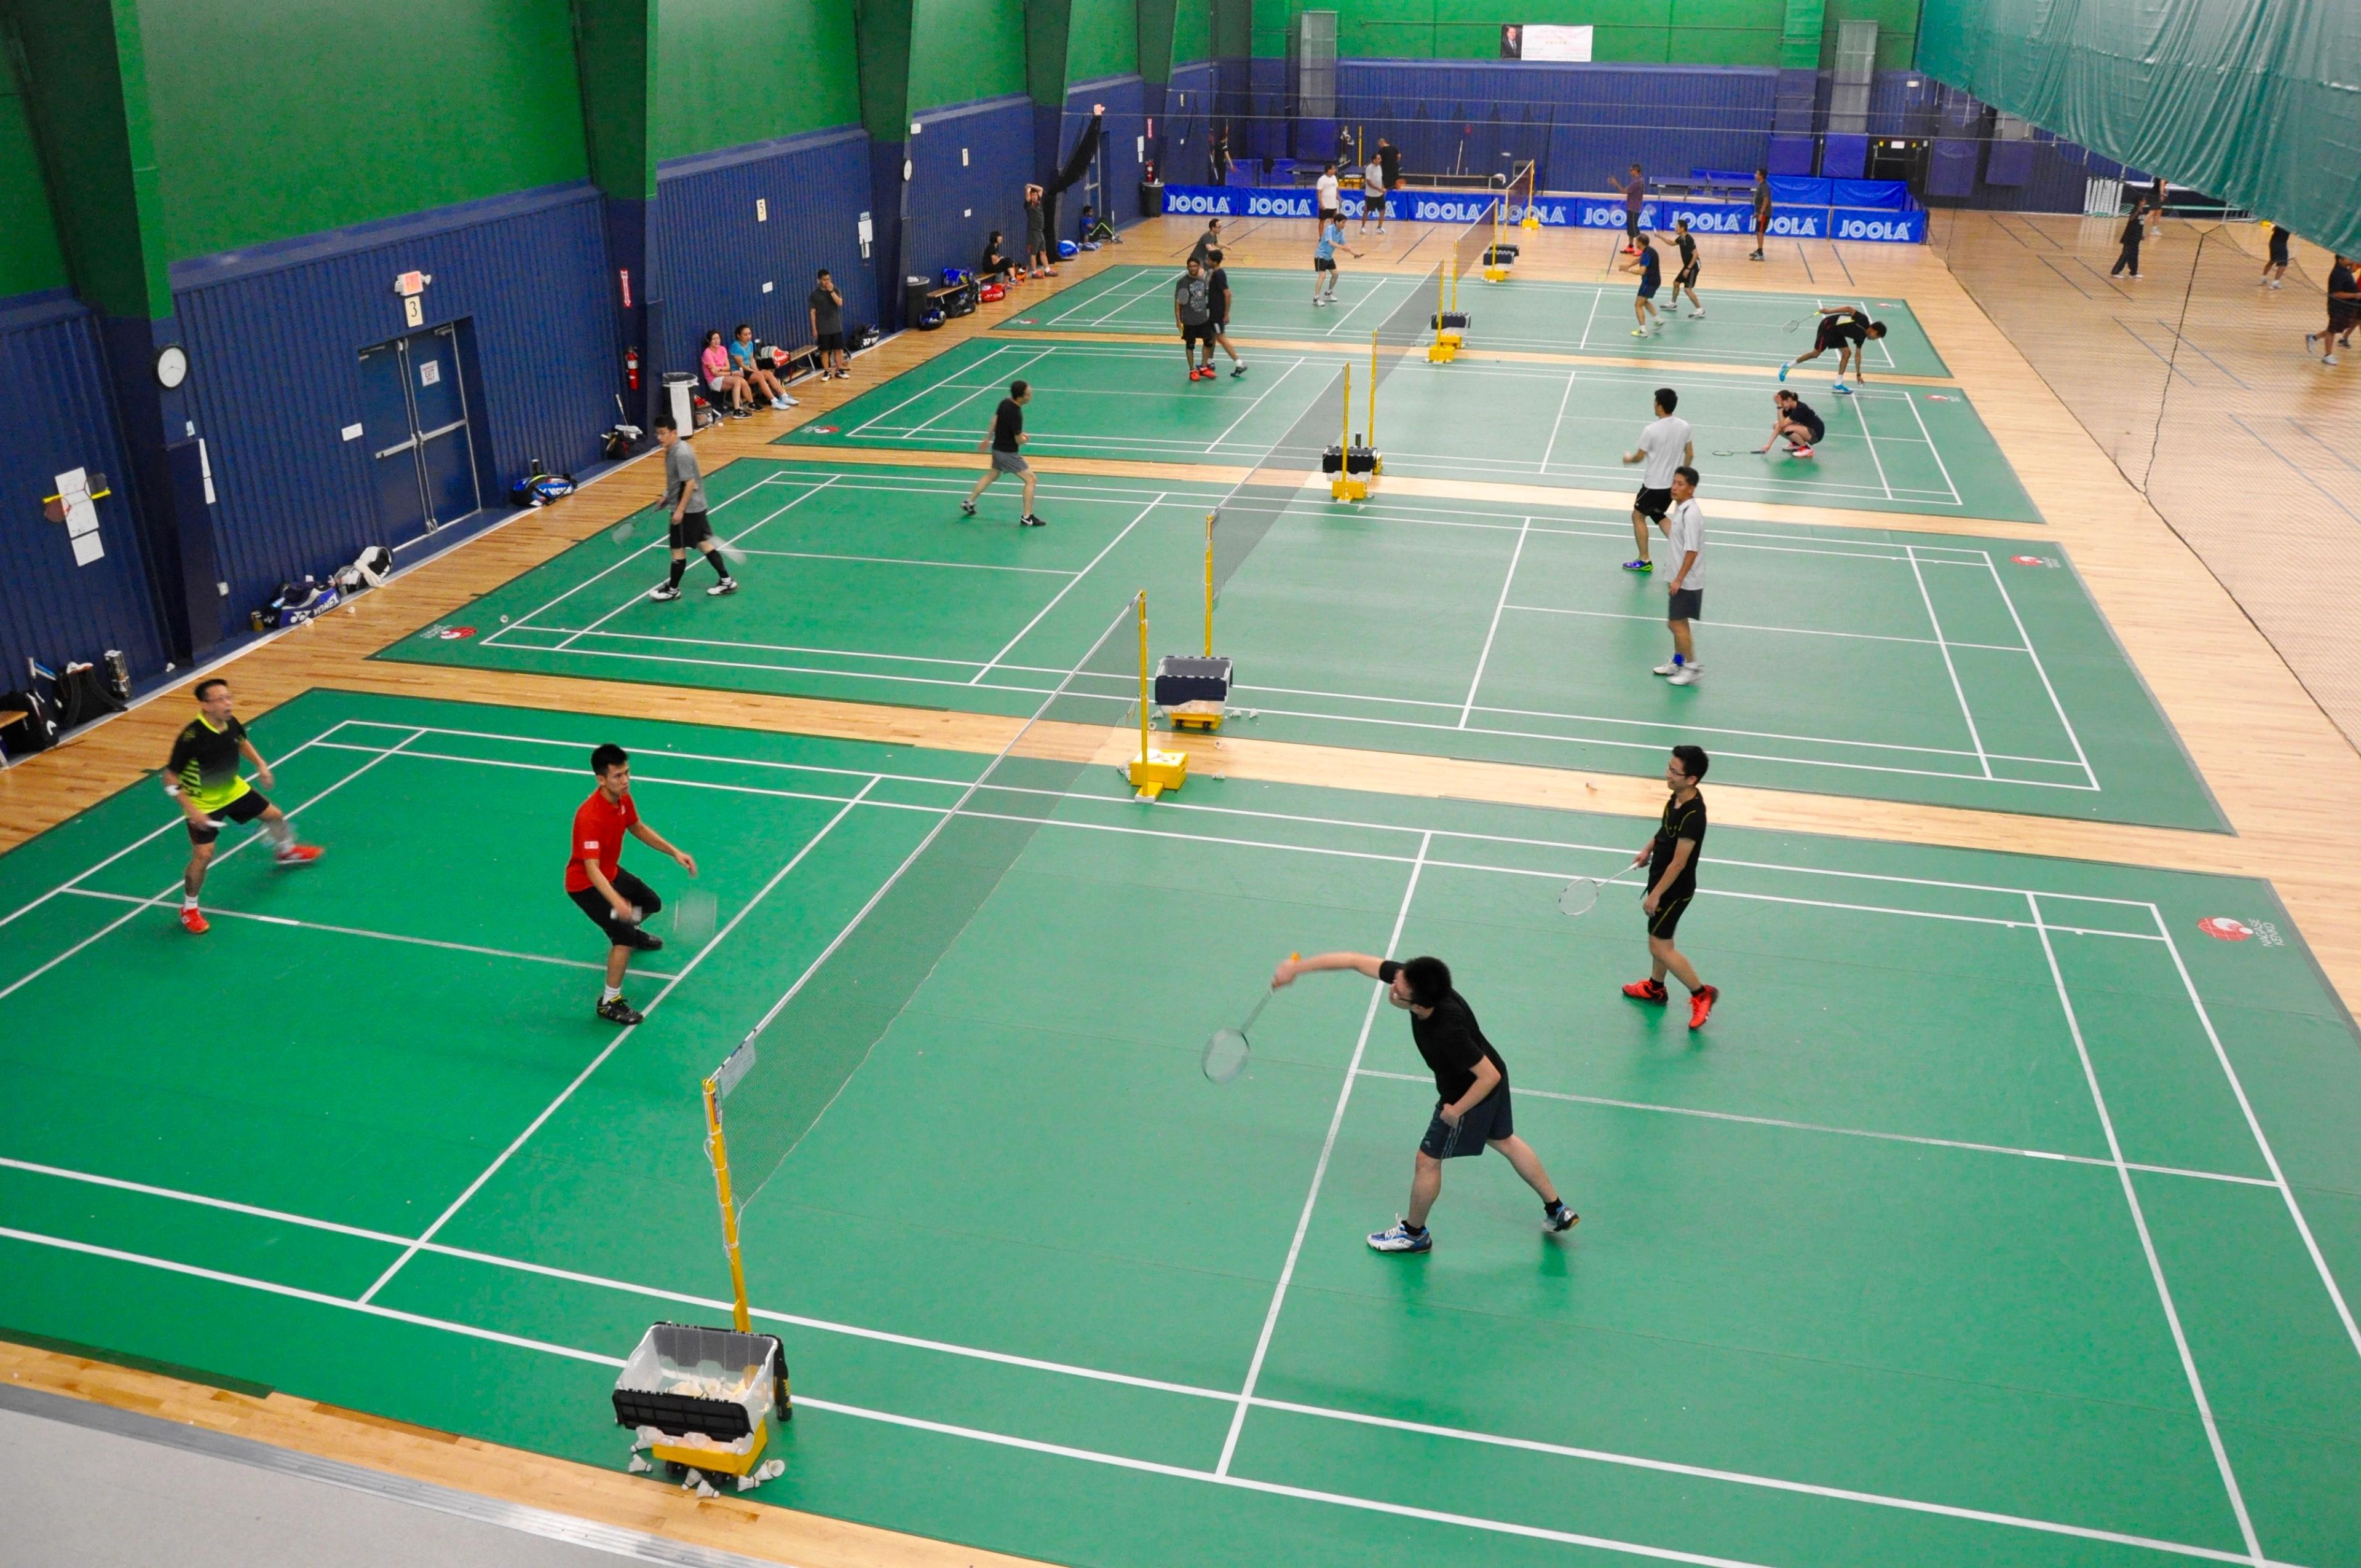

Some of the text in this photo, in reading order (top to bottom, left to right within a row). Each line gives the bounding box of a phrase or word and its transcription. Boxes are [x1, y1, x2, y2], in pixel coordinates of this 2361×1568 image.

[759, 202, 764, 215] 5
[1168, 195, 1230, 213] JOOLA
[1248, 197, 1311, 215] JOOLA
[1415, 202, 1480, 220] JOOLA
[1583, 208, 1653, 227] JOOA
[1669, 211, 1740, 232] JOOLA
[1749, 215, 1816, 235] JOLA
[1839, 219, 1910, 240] JOOLA
[409, 301, 417, 318] 3
[2248, 918, 2273, 947] NAGASE
[2263, 922, 2285, 946] KENKO
